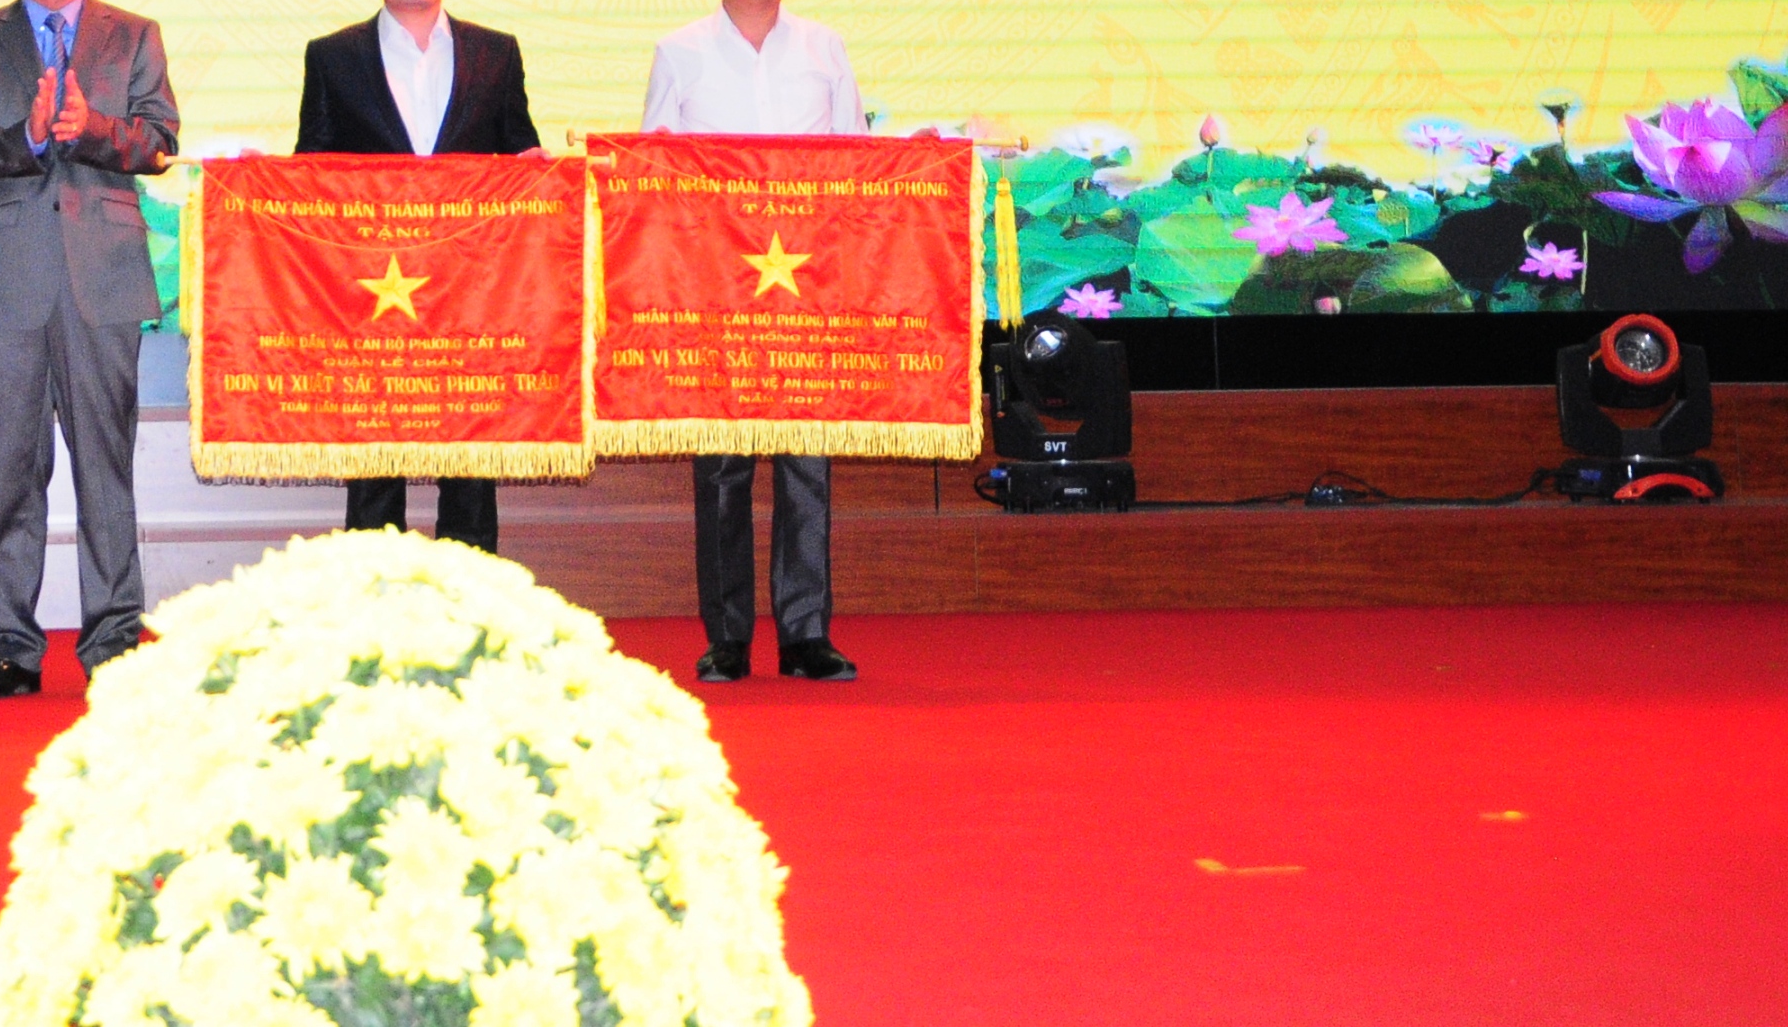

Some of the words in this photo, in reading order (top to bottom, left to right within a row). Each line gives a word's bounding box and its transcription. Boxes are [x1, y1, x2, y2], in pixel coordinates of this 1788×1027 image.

[638, 177, 671, 191] BAN
[677, 174, 720, 193] NHÂN
[252, 198, 286, 214] BAN
[292, 199, 335, 216] NHÂN
[742, 201, 814, 217] TẶNG
[357, 224, 430, 241] TẶNG
[651, 349, 669, 368] VỊ
[767, 350, 824, 369] TRONG
[831, 352, 889, 370] PHONG
[266, 374, 283, 395] VỊ
[383, 375, 440, 393] TRONG
[447, 375, 505, 392] PHONG
[783, 377, 800, 388] AN
[805, 379, 834, 390] NINH
[391, 403, 408, 413] AN
[412, 403, 441, 413] NINH
[1044, 441, 1067, 452] SVT
